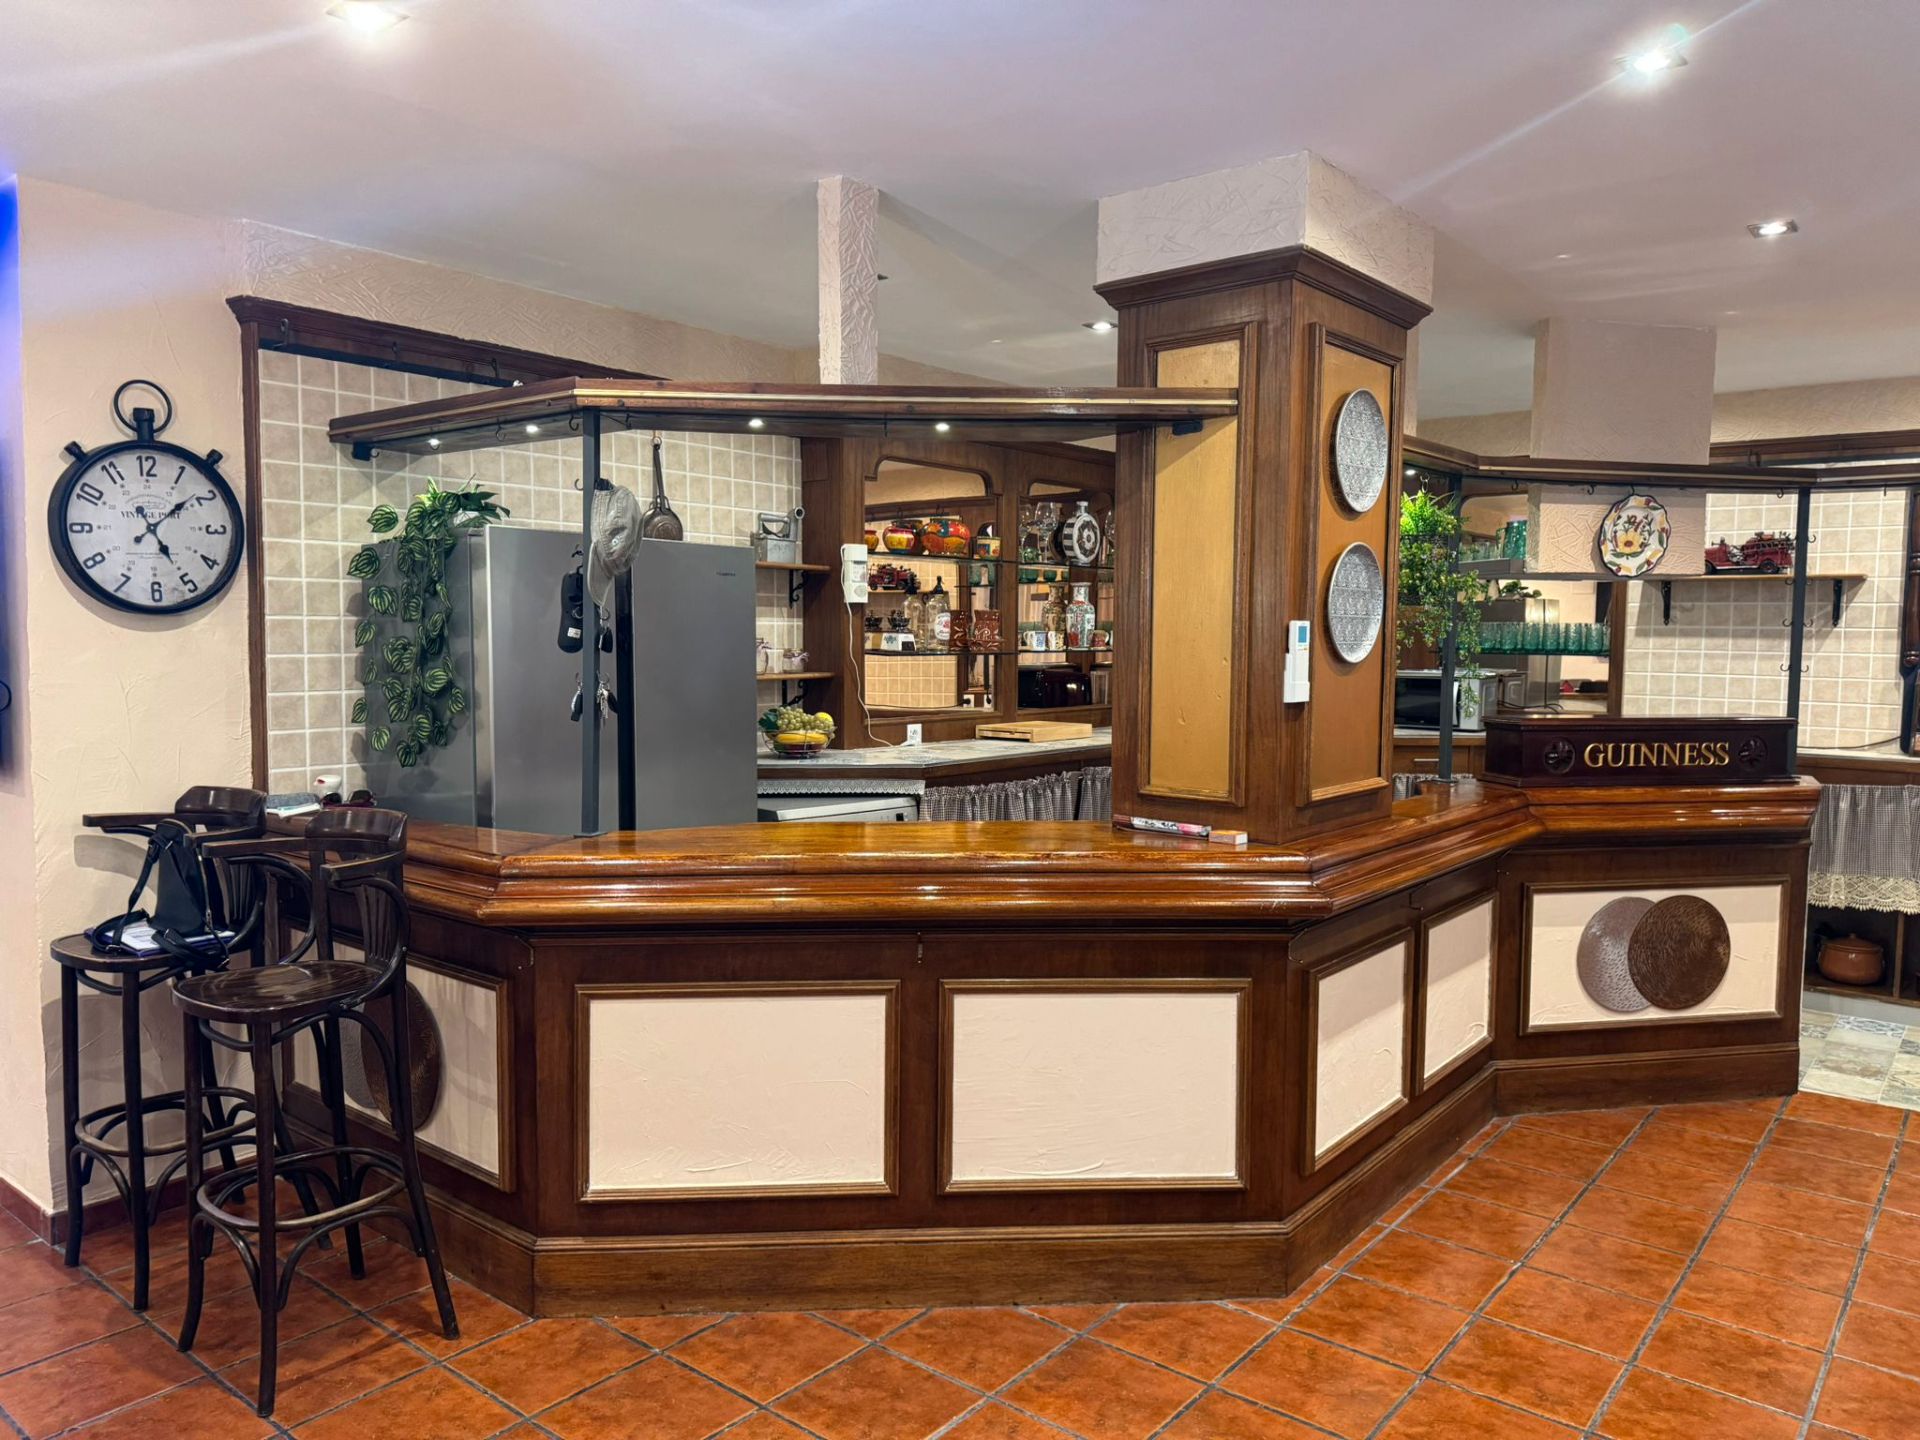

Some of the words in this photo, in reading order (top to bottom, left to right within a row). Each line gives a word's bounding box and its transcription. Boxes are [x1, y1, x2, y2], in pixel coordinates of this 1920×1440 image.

[100, 460, 125, 485] 11
[136, 455, 158, 478] 12
[173, 465, 187, 485] 1
[75, 482, 104, 507] 10
[195, 489, 217, 507] 2
[68, 522, 93, 534] 9
[205, 524, 227, 535] 3
[83, 552, 106, 570] 8
[200, 554, 220, 571] 4
[113, 573, 131, 593] 7
[150, 581, 163, 603] 6
[179, 572, 198, 594] 5
[1583, 741, 1730, 768] GUINNESS
